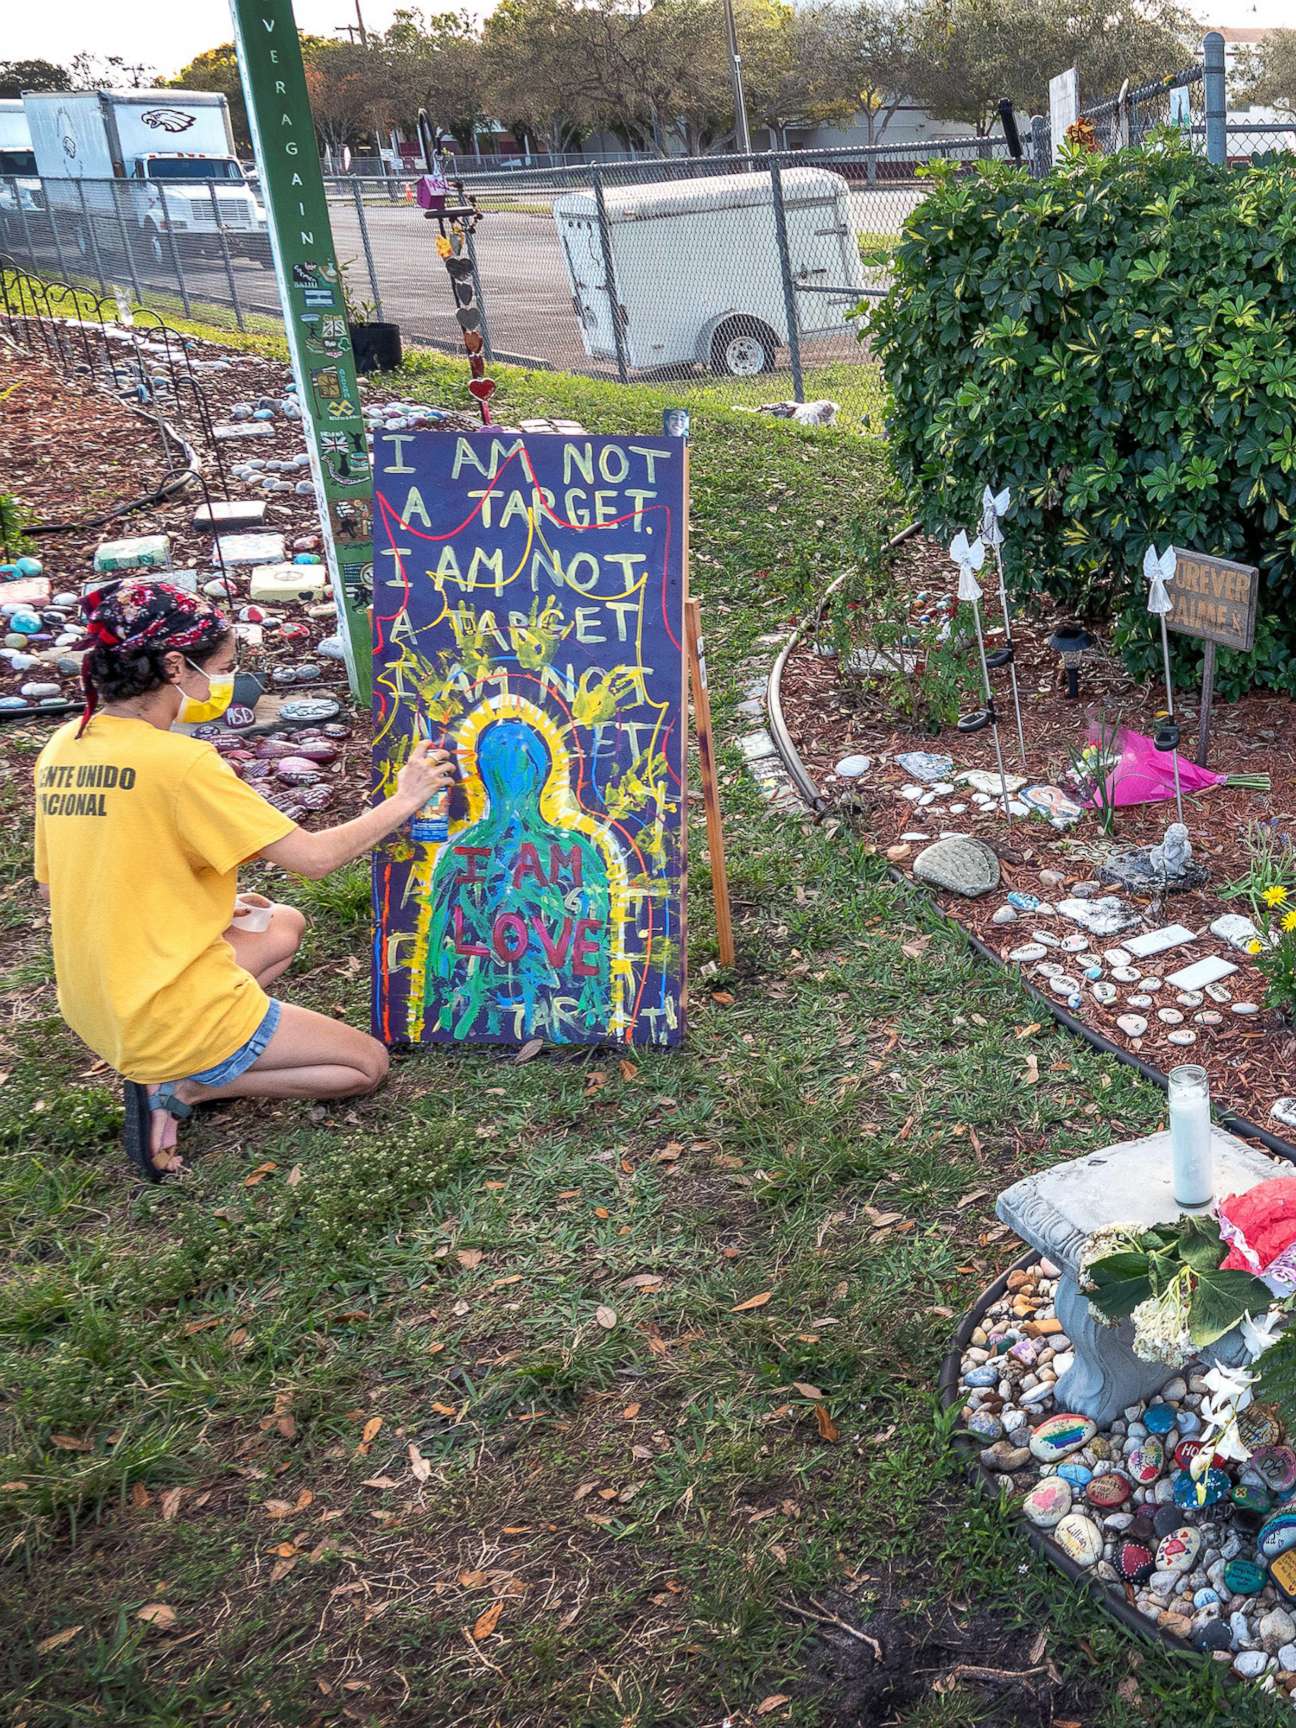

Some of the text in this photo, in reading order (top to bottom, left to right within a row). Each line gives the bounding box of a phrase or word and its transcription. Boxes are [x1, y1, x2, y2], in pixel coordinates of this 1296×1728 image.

[382, 434, 672, 485] I AM NOT
[400, 486, 432, 531] A
[380, 545, 647, 597] I AM NOT
[1167, 559, 1249, 604] OREVER
[389, 606, 418, 645] A
[441, 662, 509, 704] AM
[539, 662, 655, 706] NOT
[76, 764, 137, 790] UNIDO
[453, 842, 584, 889] I AM
[453, 905, 603, 977] LOVE
